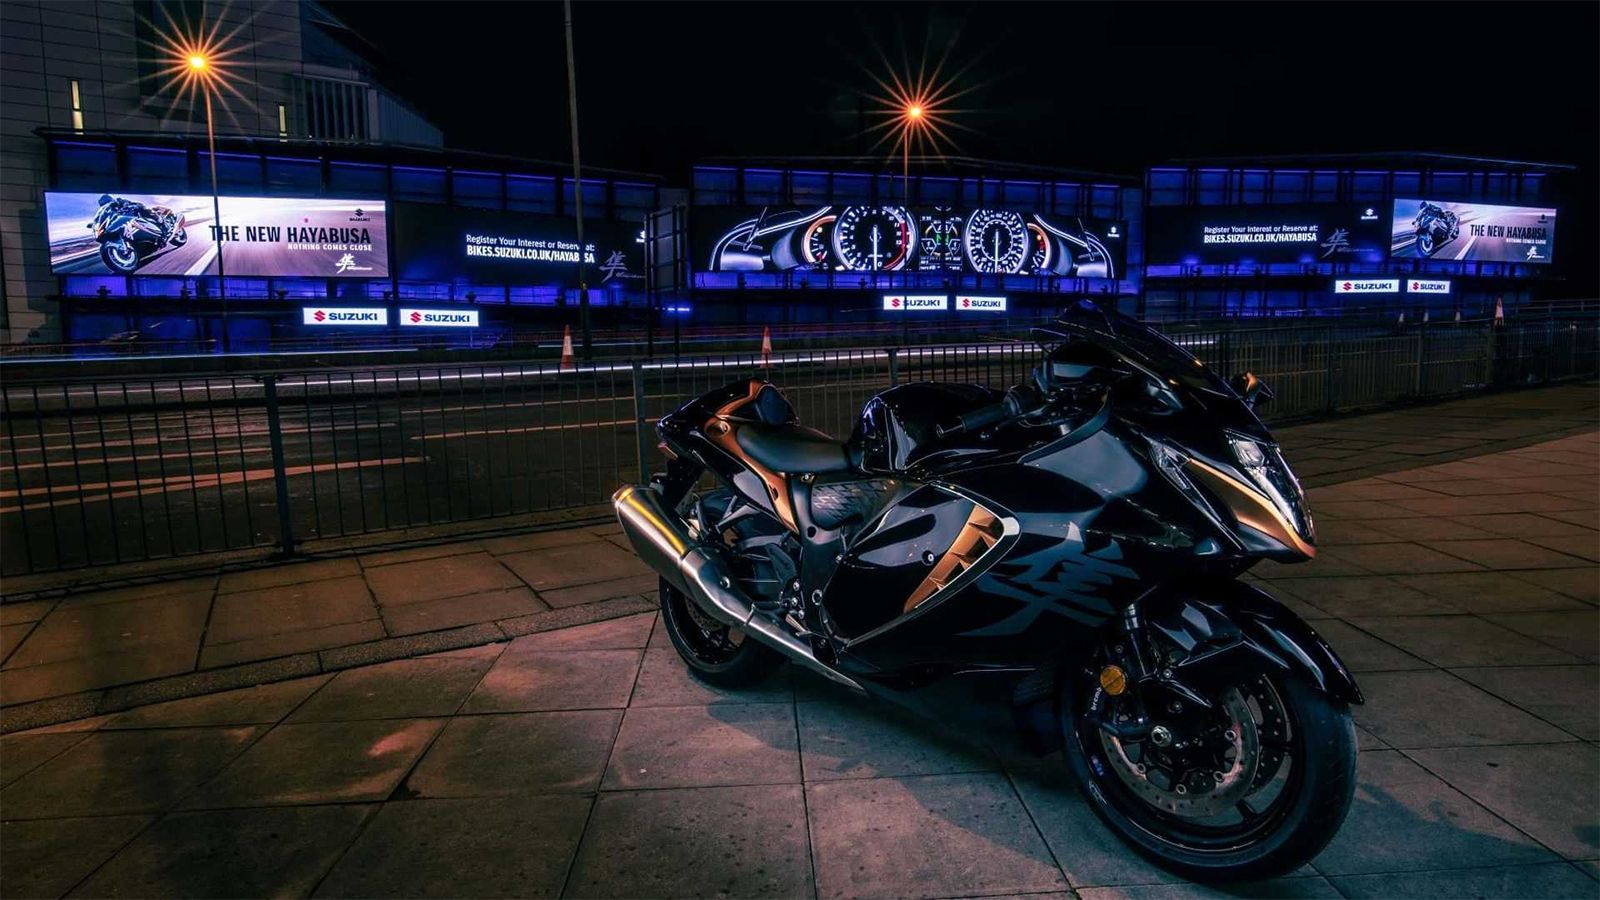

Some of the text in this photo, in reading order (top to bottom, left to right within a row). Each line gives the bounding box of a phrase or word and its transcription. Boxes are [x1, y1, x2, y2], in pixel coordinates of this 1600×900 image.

[208, 225, 371, 244] THE NEW HAYABUSA
[1203, 226, 1230, 235] Register
[1231, 226, 1247, 234] Your
[1247, 225, 1272, 233] Interest
[1308, 224, 1319, 232] at:
[1470, 225, 1547, 240] THE NEW HAYABUSA
[466, 234, 498, 246] Register
[499, 236, 516, 246] Your
[518, 238, 547, 248] Interest
[1203, 231, 1318, 244] BIKES.SUZUKI.CO.UK/HAYABUSA
[349, 244, 373, 252] CLOSE
[466, 244, 595, 264] BIKES.SUZUKI.CO.UK/HAYABSA
[1420, 283, 1447, 291] SUZUKI
[971, 300, 1001, 308] SUZUKI
[329, 312, 378, 321] SUZUKI
[424, 314, 470, 322] SUZUKI
